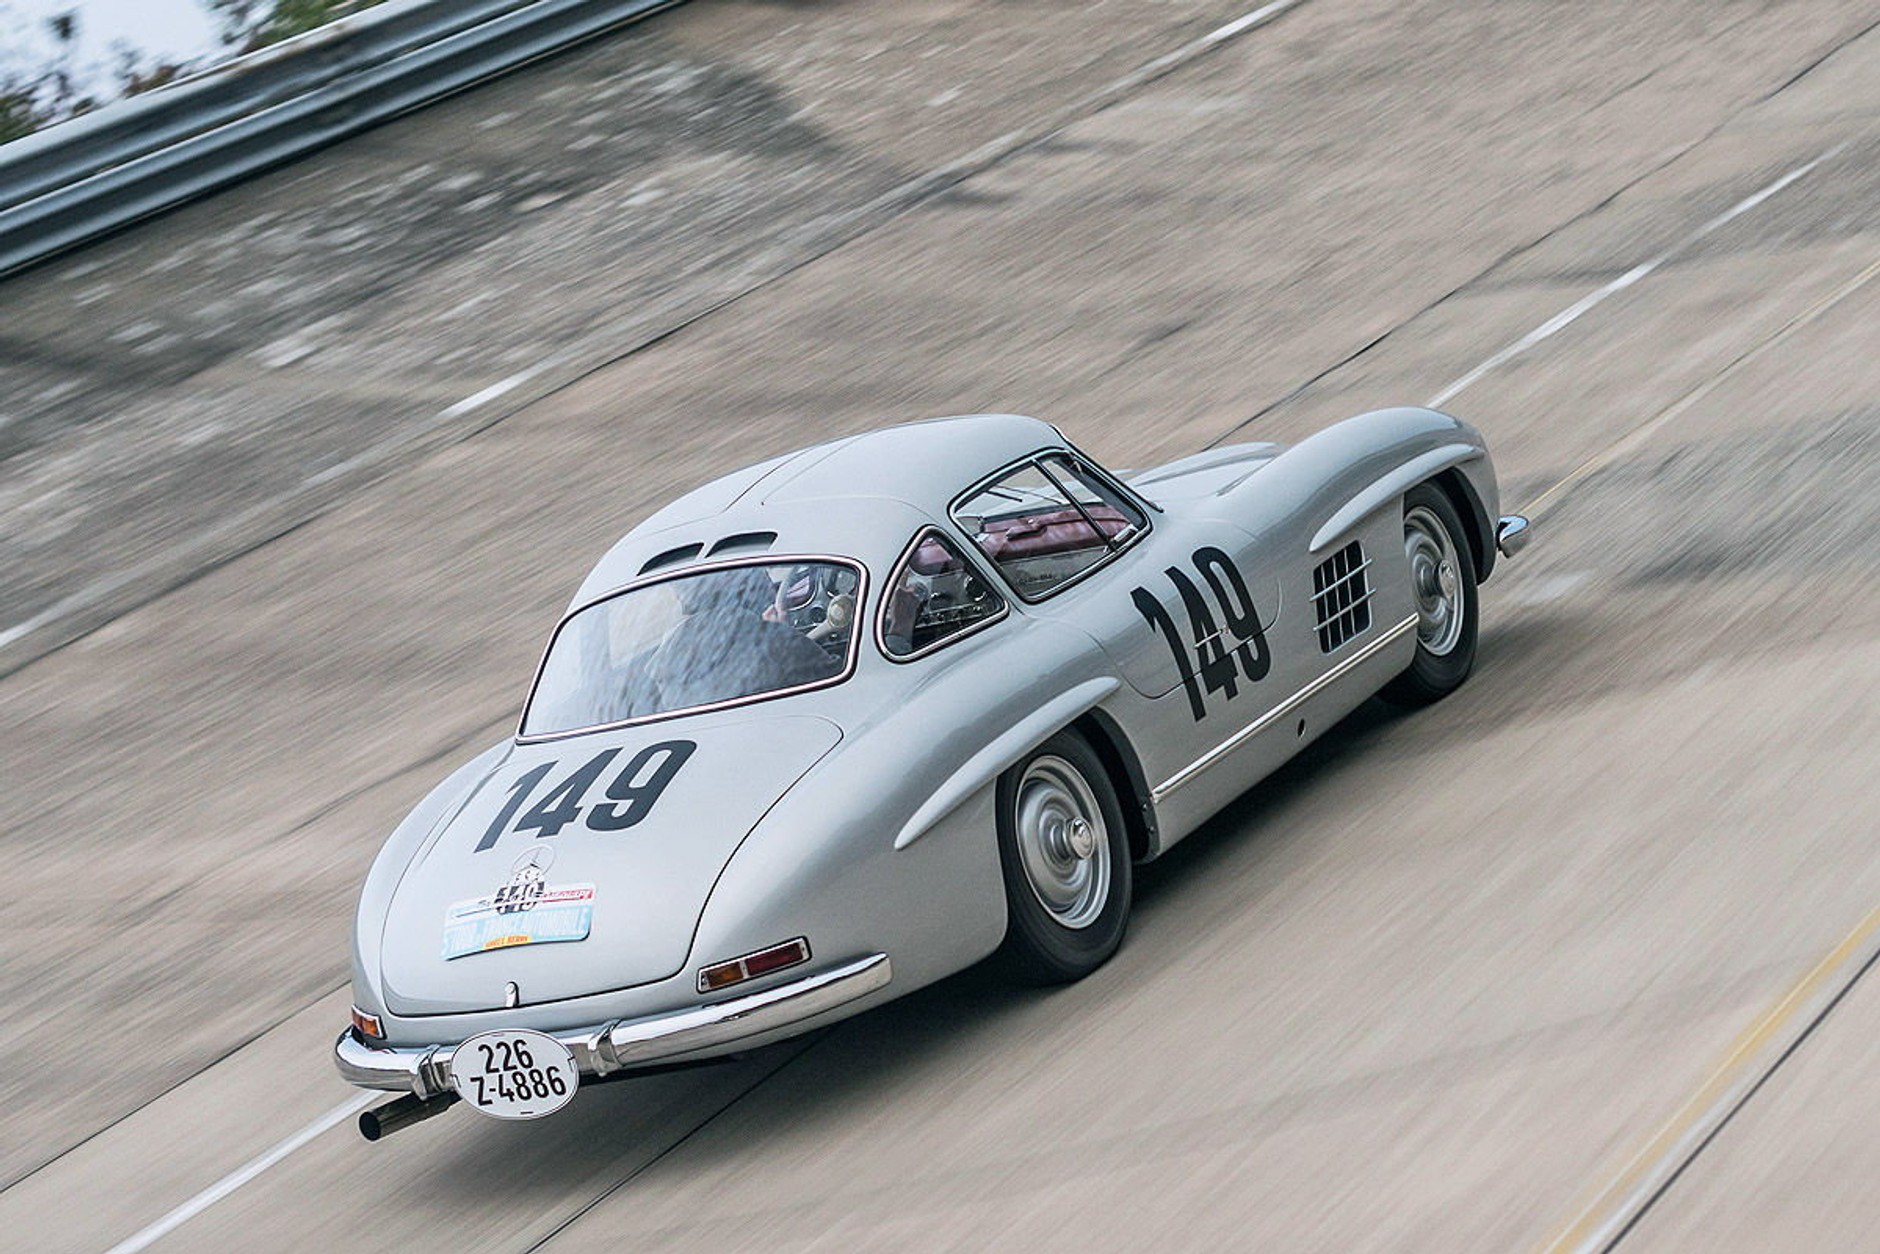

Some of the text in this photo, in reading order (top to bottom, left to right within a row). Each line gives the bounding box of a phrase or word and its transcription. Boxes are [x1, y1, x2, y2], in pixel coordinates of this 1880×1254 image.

[1130, 546, 1271, 722] 149
[474, 740, 697, 853] 149
[470, 1066, 567, 1106] Z-4886
[478, 1039, 533, 1074] 226
